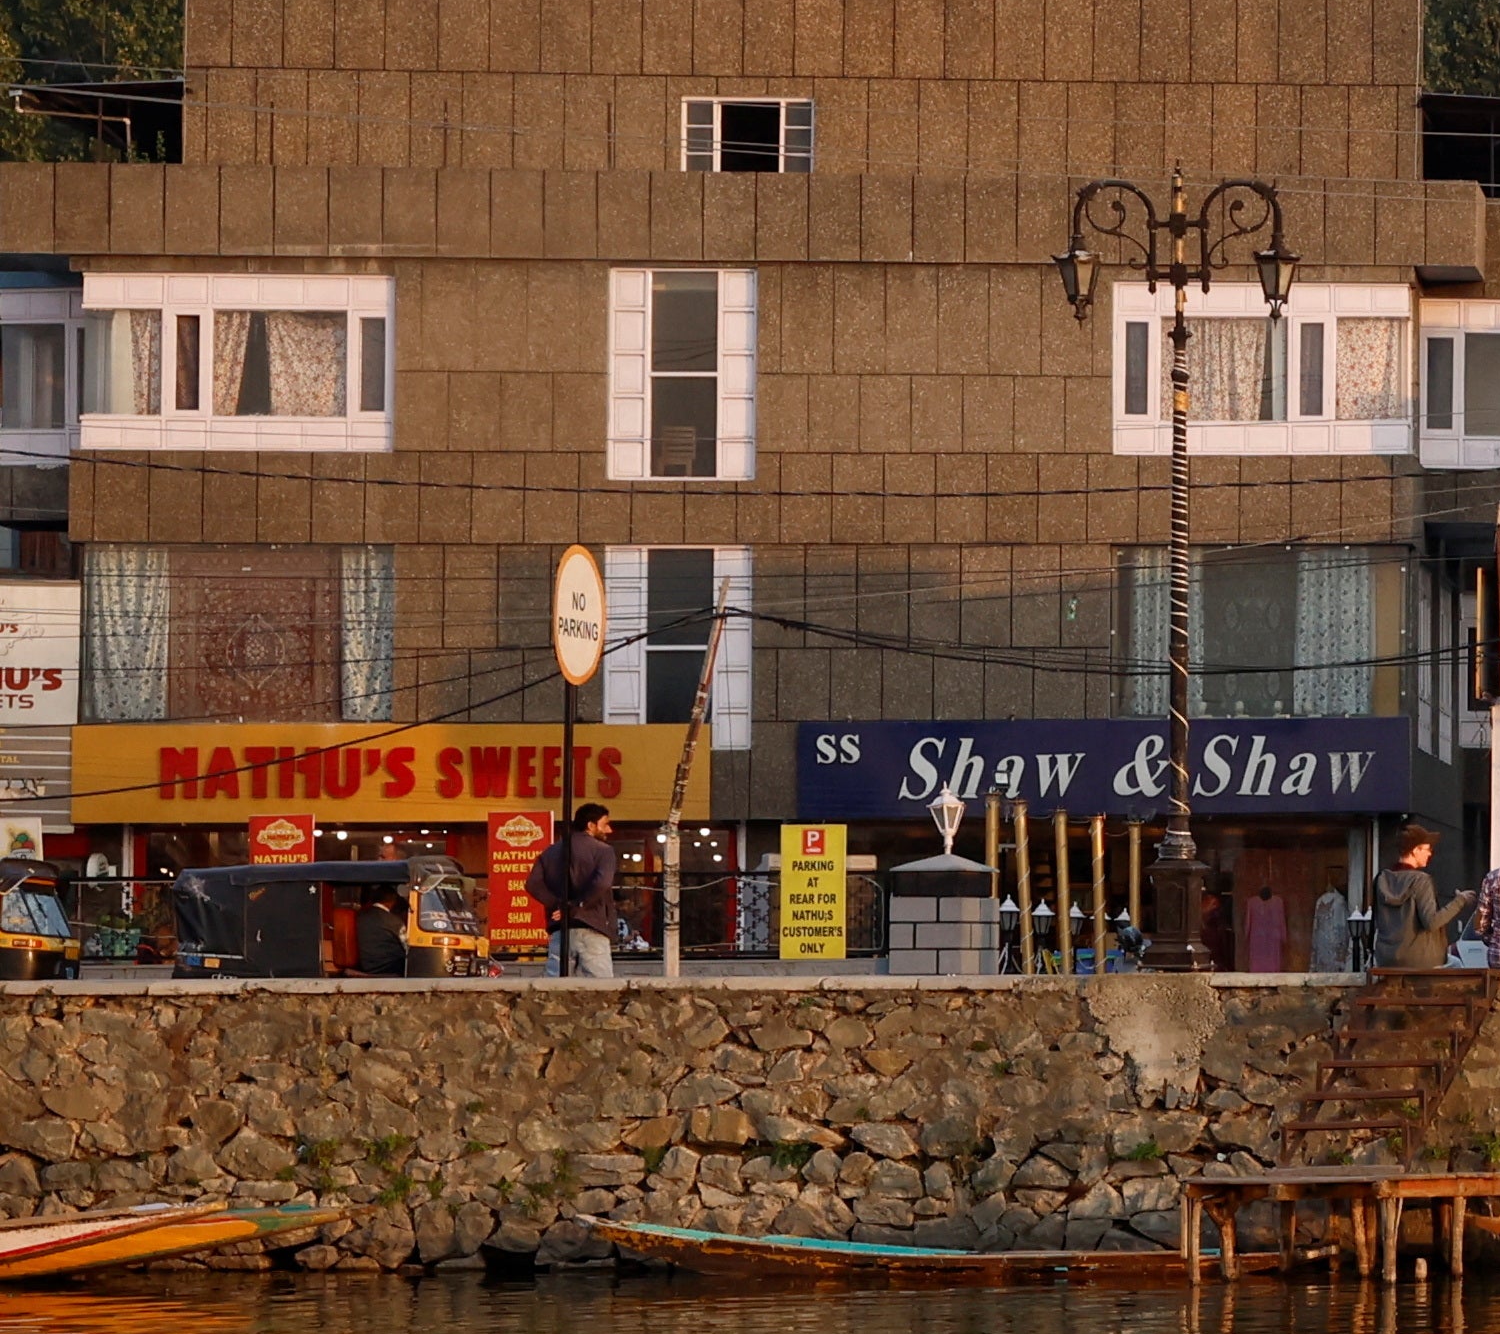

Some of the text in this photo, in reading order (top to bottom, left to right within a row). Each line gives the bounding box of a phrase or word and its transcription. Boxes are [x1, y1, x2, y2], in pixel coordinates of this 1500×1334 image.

[572, 592, 586, 611] NO
[558, 616, 598, 642] PARKING
[0, 666, 63, 691] U'S
[816, 734, 860, 764] SS
[160, 746, 623, 799] NATHU'S SWEETS
[899, 734, 1377, 800] Shaw & Shaw
[493, 851, 542, 860] NATHU'
[493, 863, 534, 873] SWEET
[792, 860, 834, 871] PARKING
[508, 879, 526, 891] SHA
[807, 877, 819, 888] AT
[511, 896, 528, 907] AND
[789, 894, 836, 905] REAR FOR
[508, 912, 532, 923] SHAW
[490, 928, 549, 940] RESTAURANTS
[782, 926, 843, 938] CUSTOMER'S
[799, 943, 825, 954] ONLY
